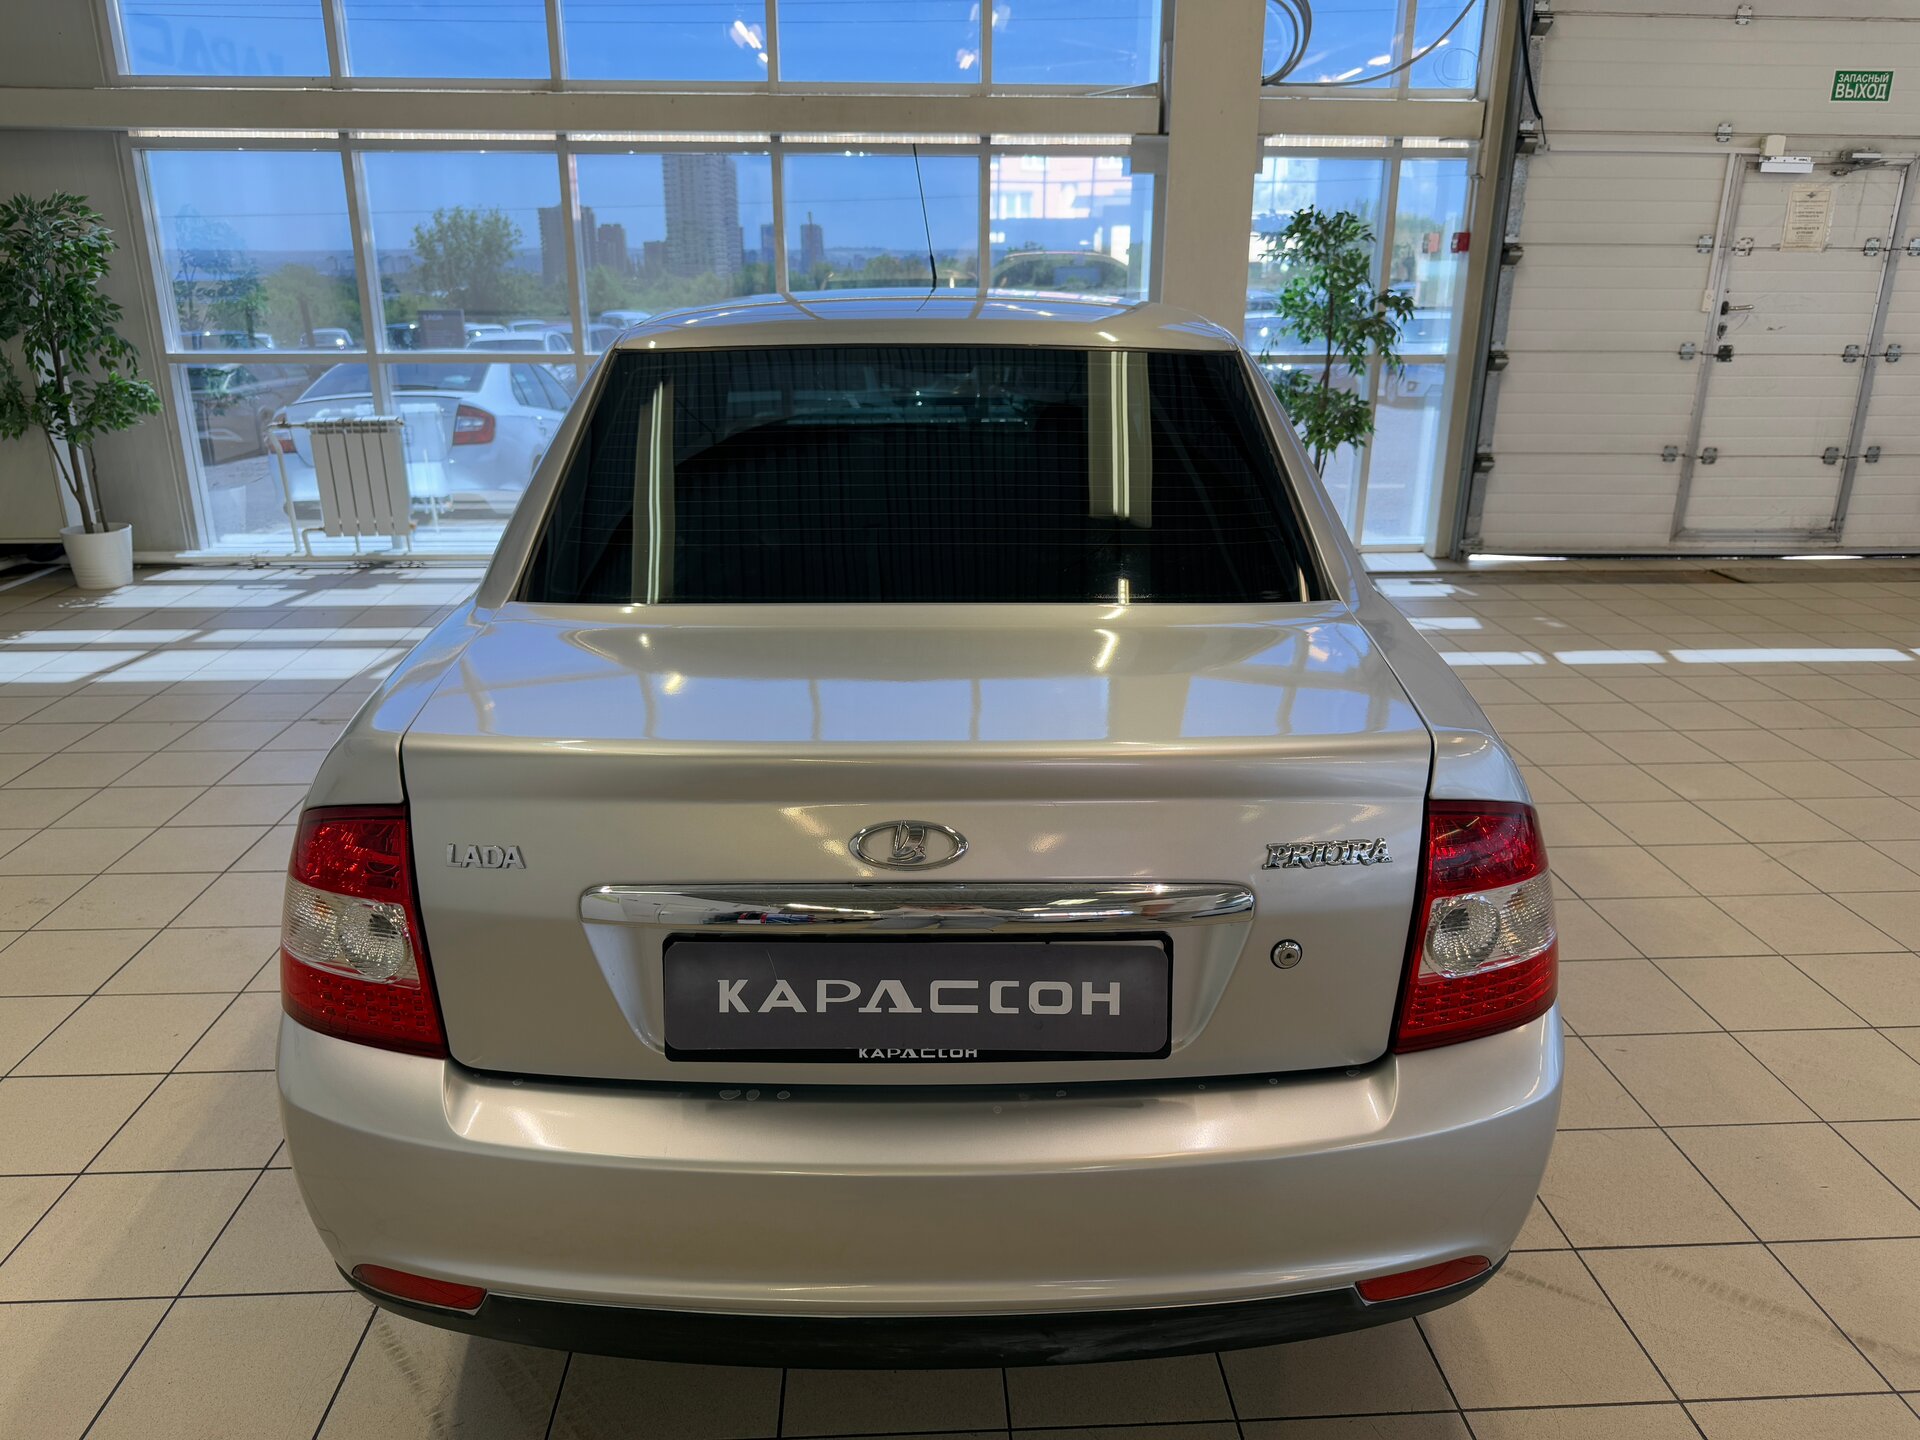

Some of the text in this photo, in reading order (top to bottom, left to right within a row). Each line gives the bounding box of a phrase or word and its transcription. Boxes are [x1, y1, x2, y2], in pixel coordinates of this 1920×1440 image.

[1837, 72, 1890, 83] ЗАПАСНЫЙ
[1834, 83, 1888, 100] ВЫХОД
[446, 842, 527, 869] LADA
[1262, 837, 1394, 870] PRIORA
[717, 978, 1122, 1017] КАРАССОН
